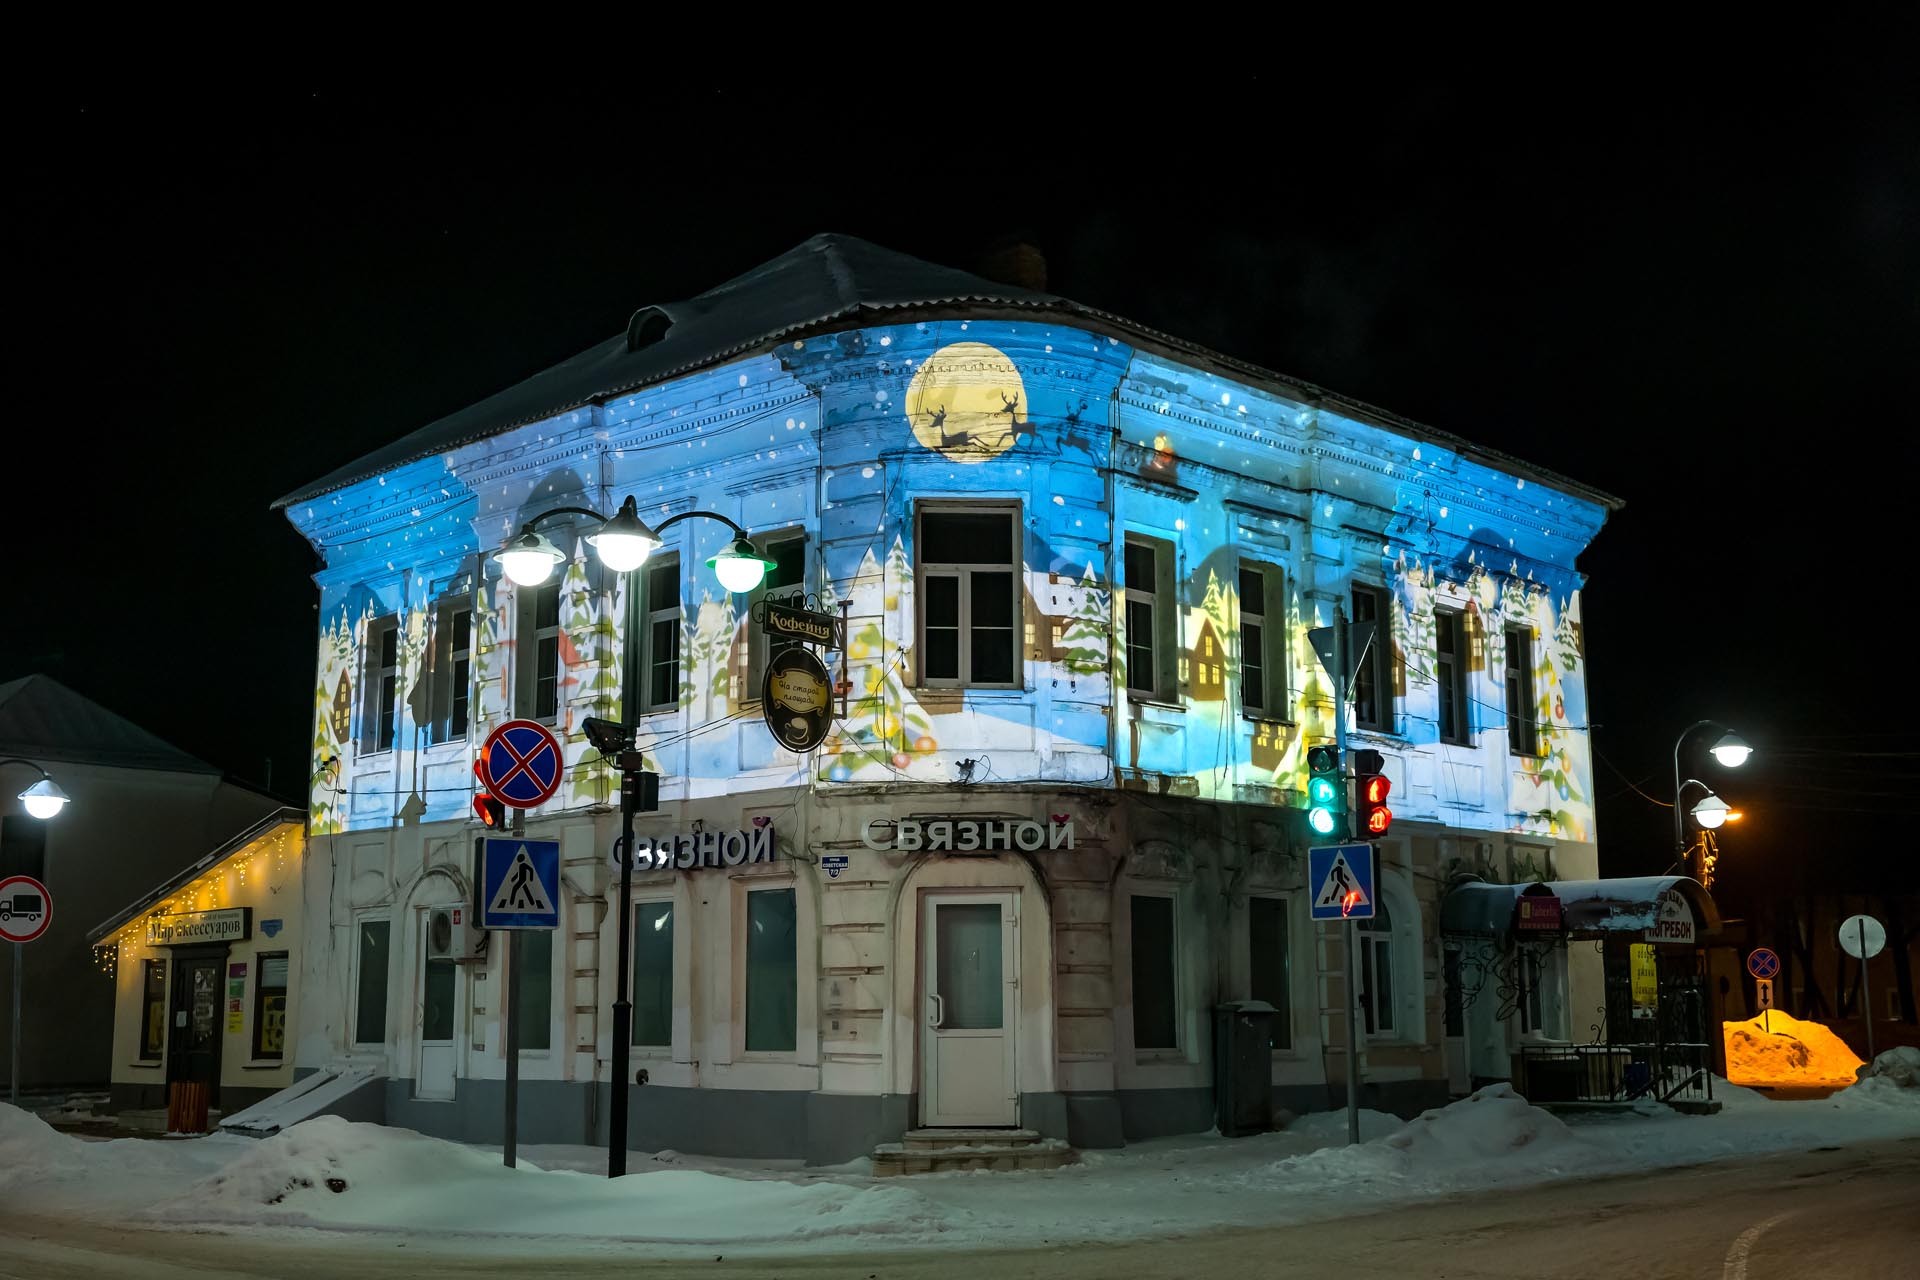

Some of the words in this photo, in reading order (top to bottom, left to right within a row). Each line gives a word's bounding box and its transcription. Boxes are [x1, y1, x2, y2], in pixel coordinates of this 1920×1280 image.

[770, 611, 830, 639] Кофейня
[861, 814, 1075, 851] СВЯЗНОЙ
[151, 922, 174, 942] Мир
[175, 919, 241, 940] аксессуаров
